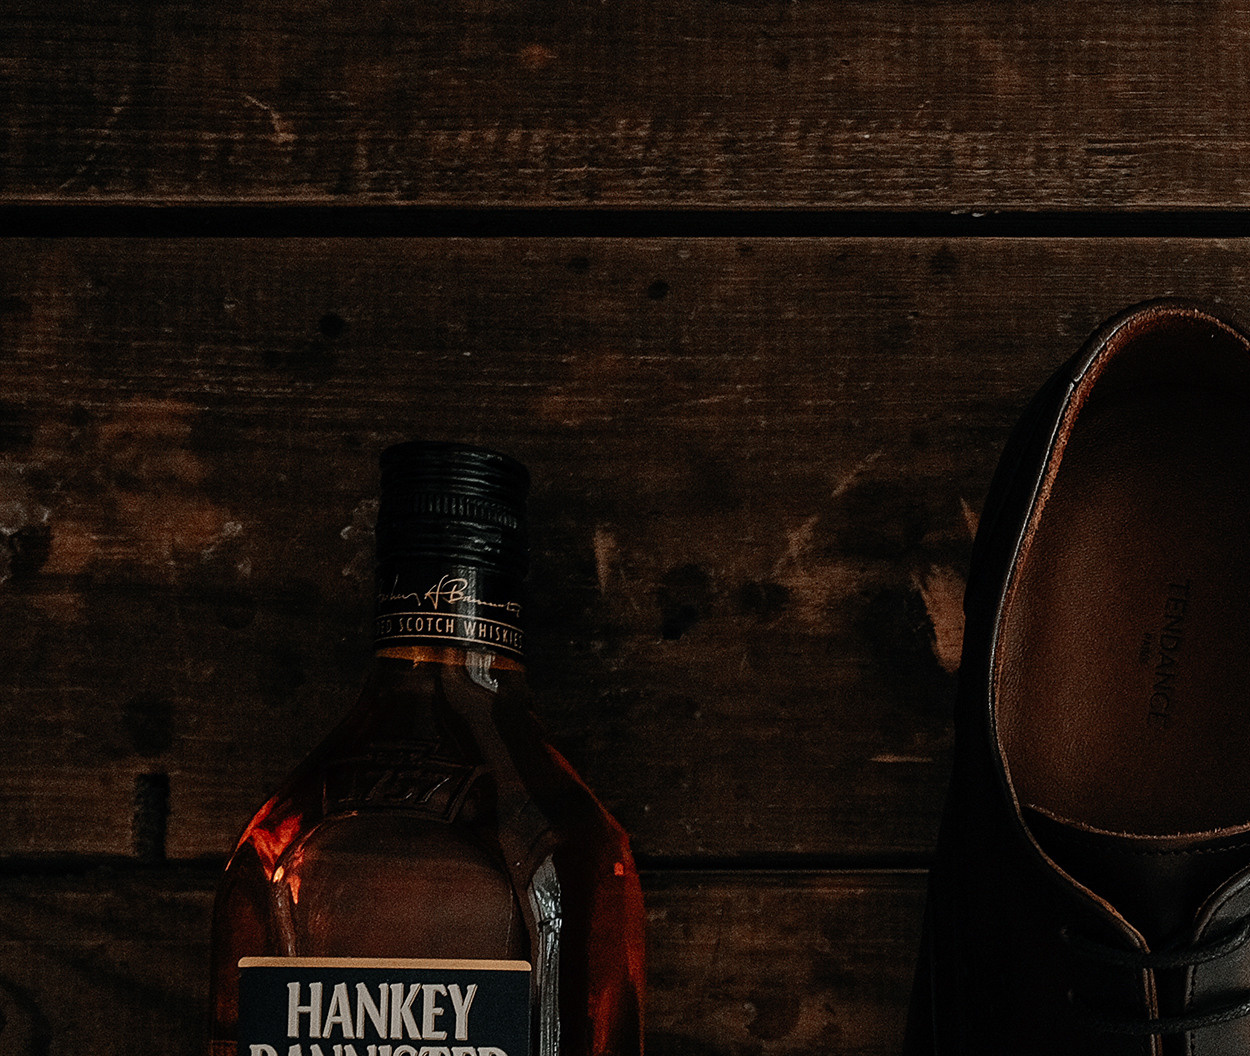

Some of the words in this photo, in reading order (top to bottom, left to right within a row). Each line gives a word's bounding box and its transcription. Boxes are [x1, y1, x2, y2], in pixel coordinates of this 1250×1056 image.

[399, 617, 455, 634] SCOTCH
[1149, 578, 1191, 730] TENDANCE
[287, 982, 478, 1041] HANKEY
